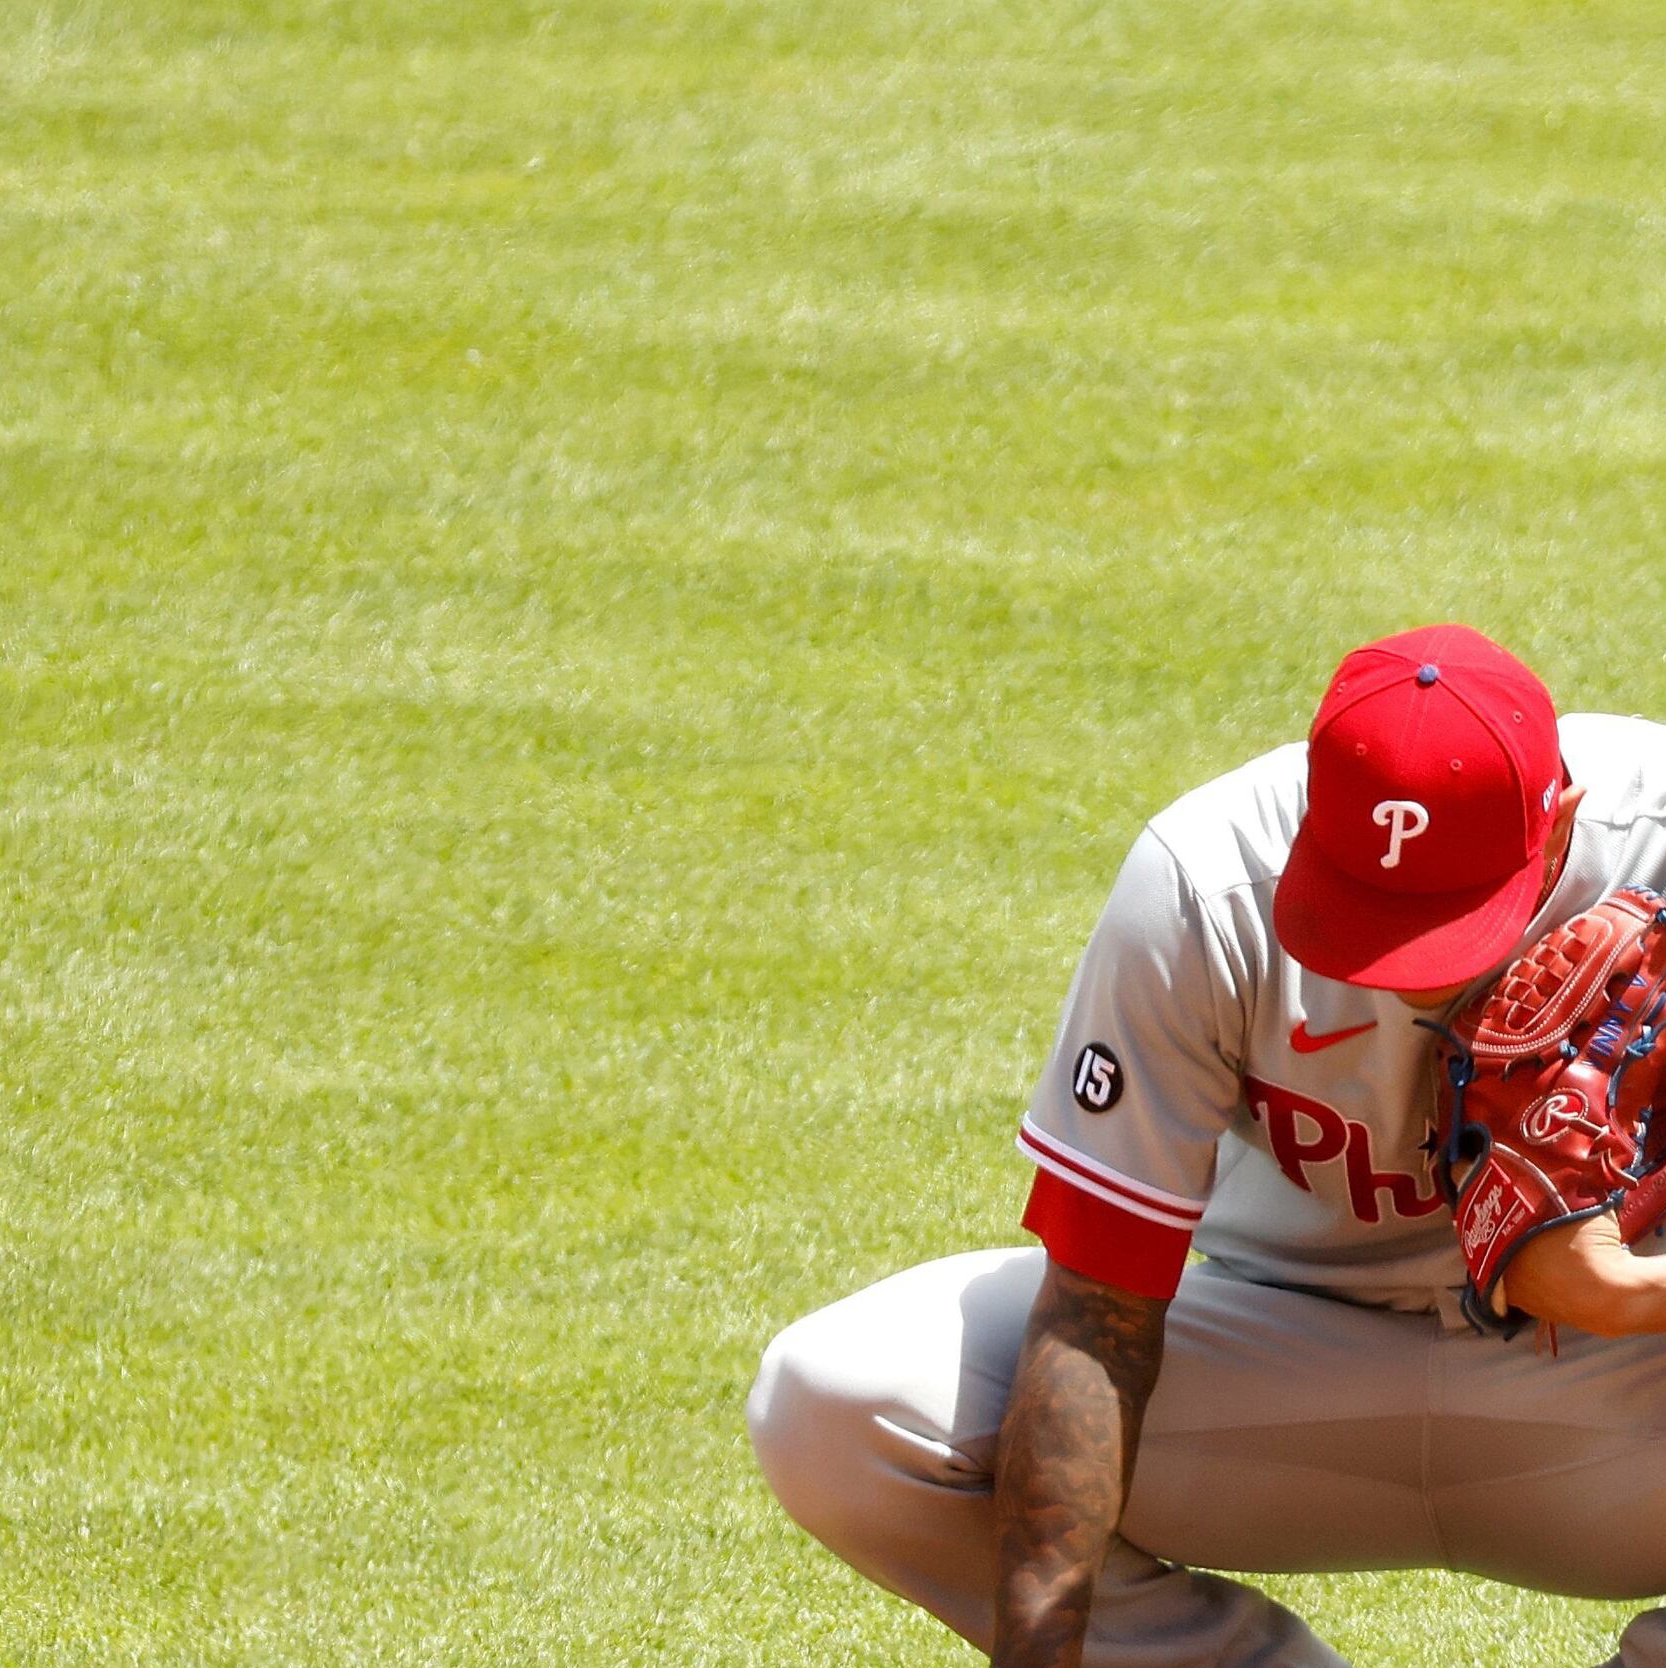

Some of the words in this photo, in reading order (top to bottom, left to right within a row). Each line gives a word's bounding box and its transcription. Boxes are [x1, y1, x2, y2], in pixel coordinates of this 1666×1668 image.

[1372, 799, 1430, 869] P
[1075, 1047, 1116, 1106] 15
[1463, 1184, 1504, 1260] Rawlings
